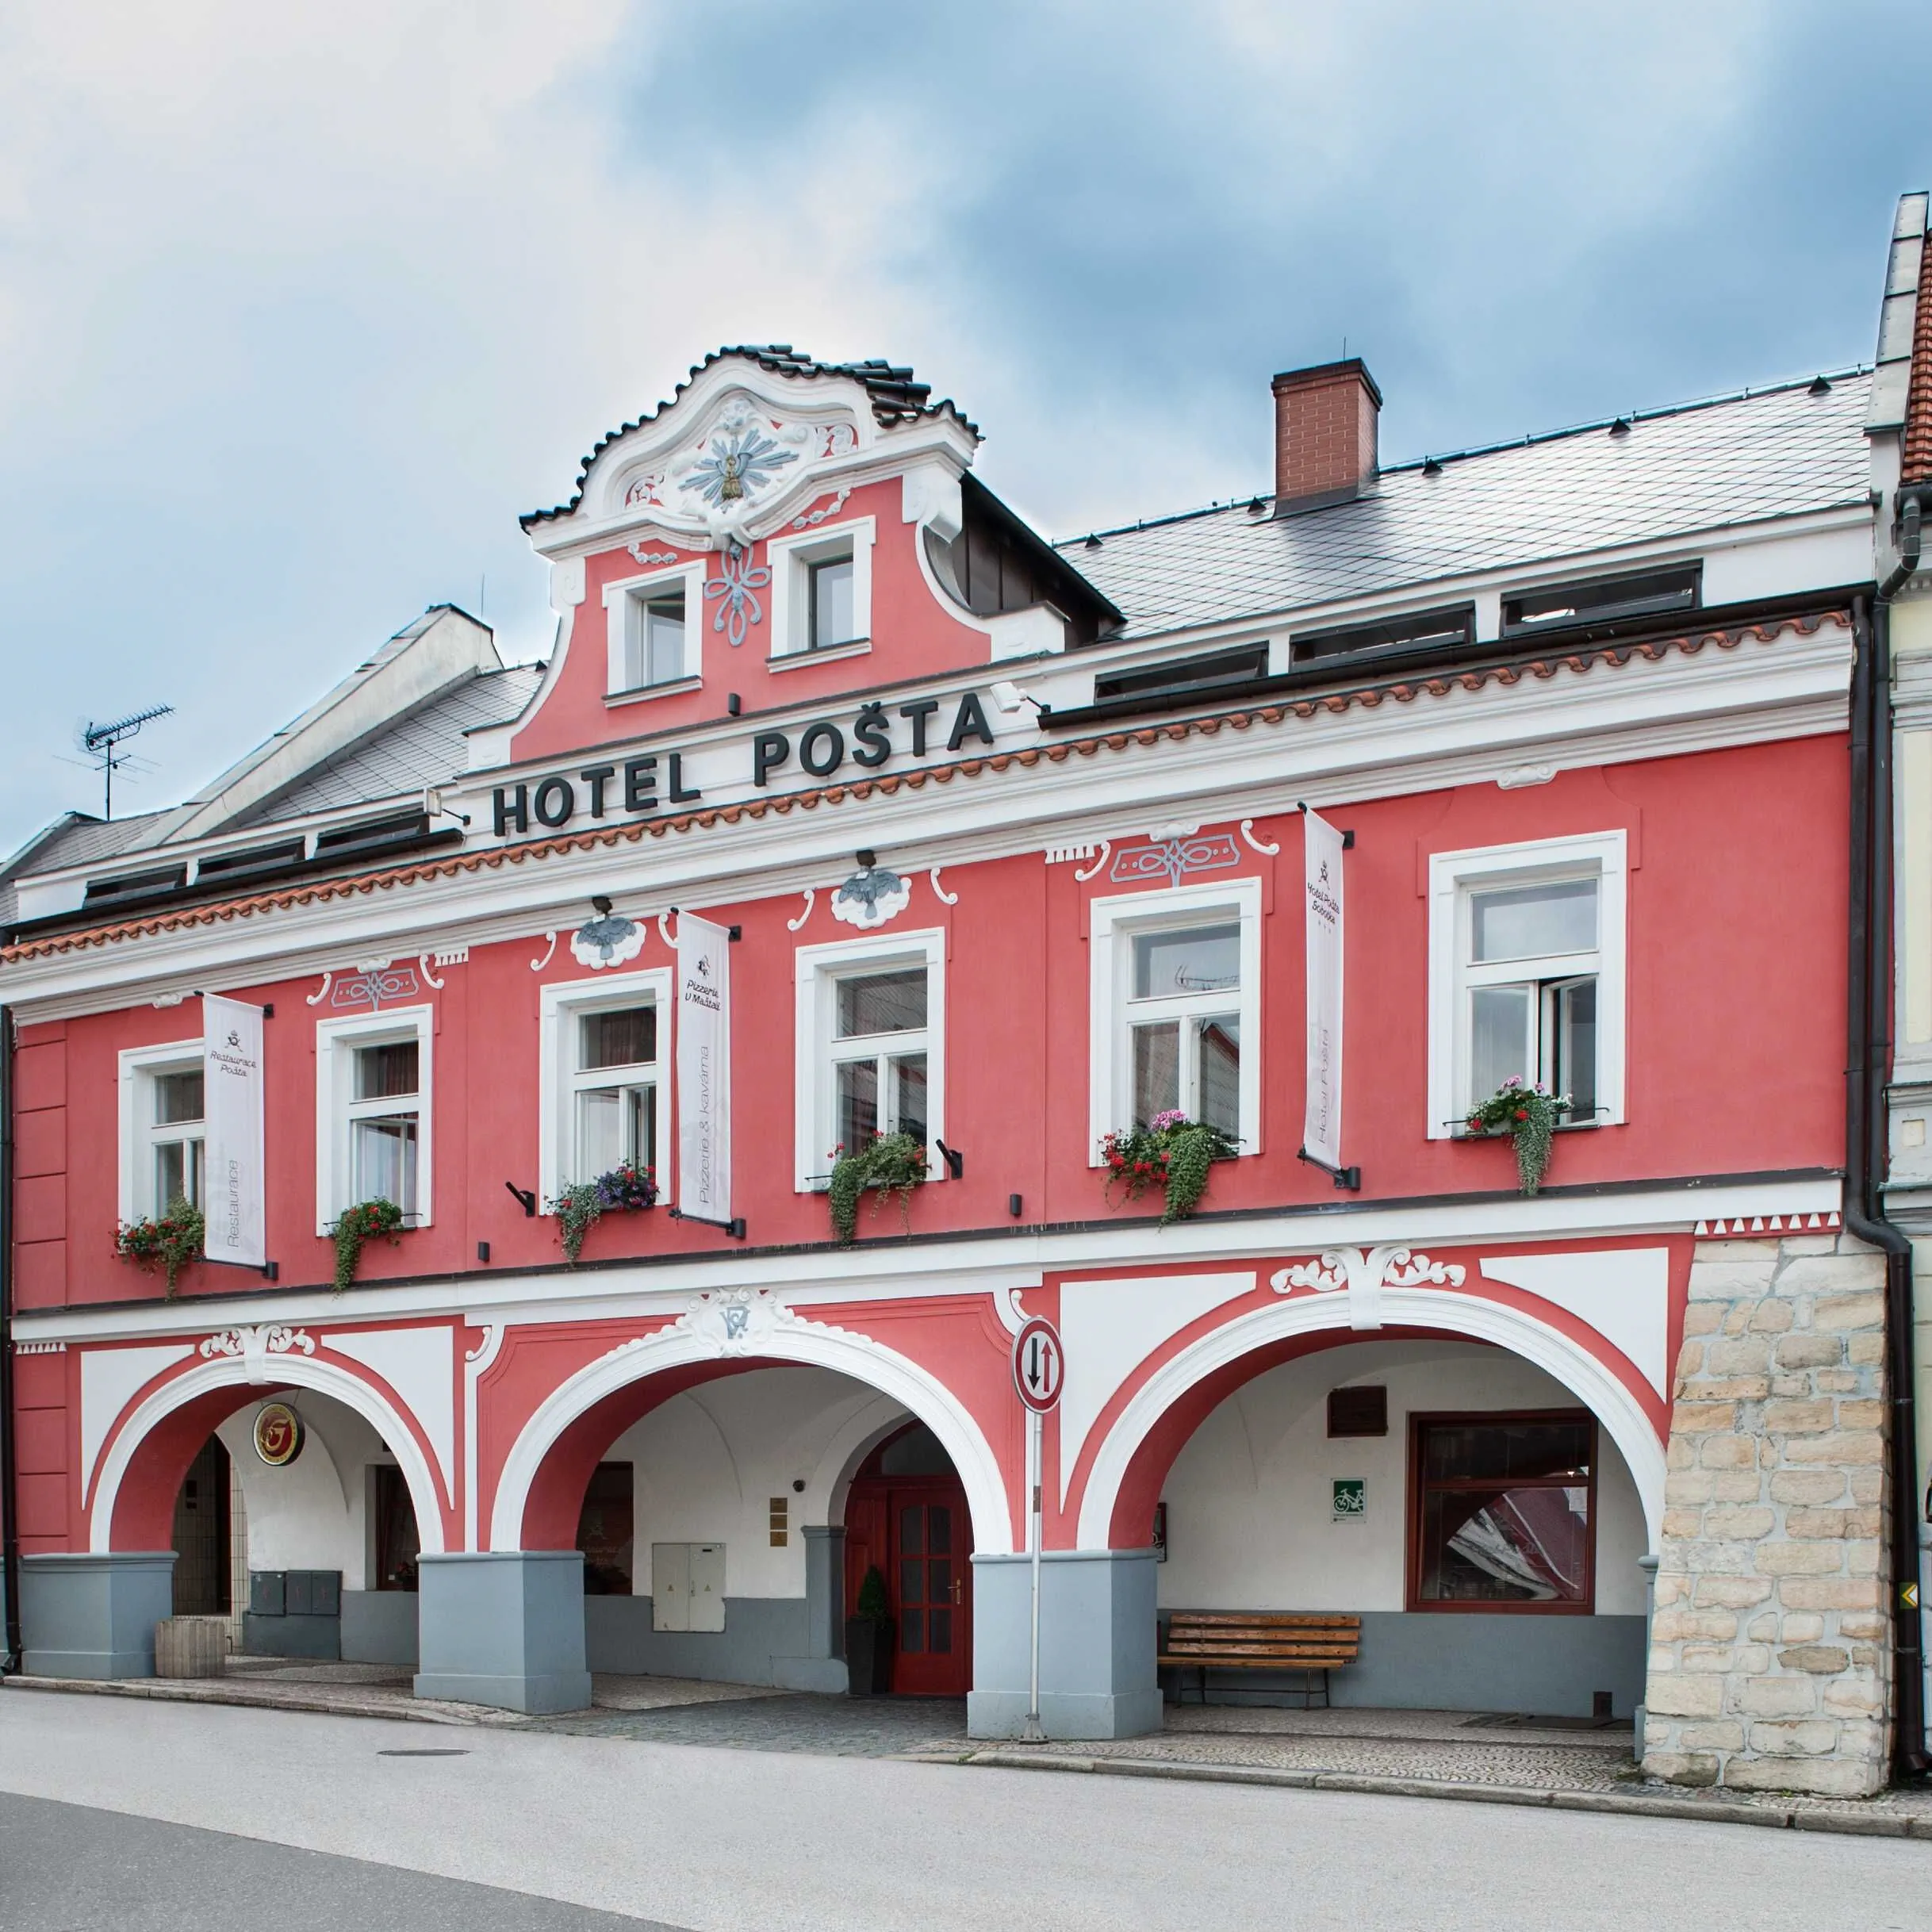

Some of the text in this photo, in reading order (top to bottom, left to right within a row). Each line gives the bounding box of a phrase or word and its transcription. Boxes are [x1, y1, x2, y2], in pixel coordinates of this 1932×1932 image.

[493, 692, 994, 837] HOTEL POŠTA
[210, 1050, 257, 1068] Restaurace
[700, 1121, 709, 1133] &
[227, 1160, 239, 1248] Restaurace
